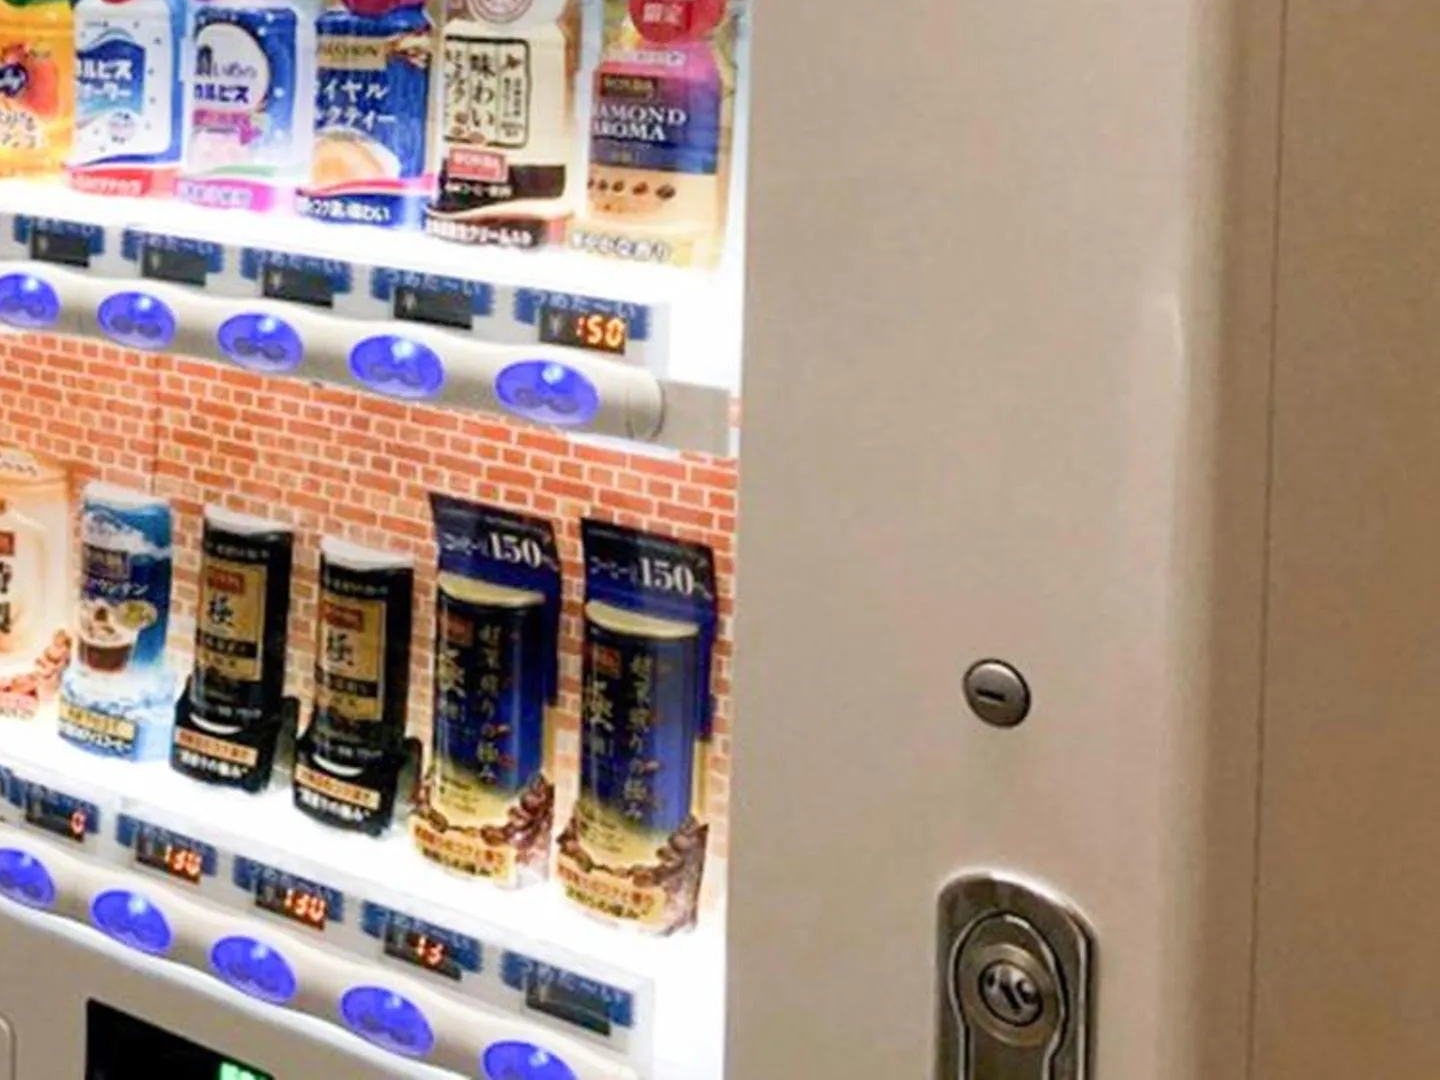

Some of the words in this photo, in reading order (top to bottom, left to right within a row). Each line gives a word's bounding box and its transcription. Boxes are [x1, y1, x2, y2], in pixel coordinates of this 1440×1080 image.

[315, 79, 390, 99] イヤル
[575, 313, 627, 349] 150
[639, 556, 696, 598] 150
